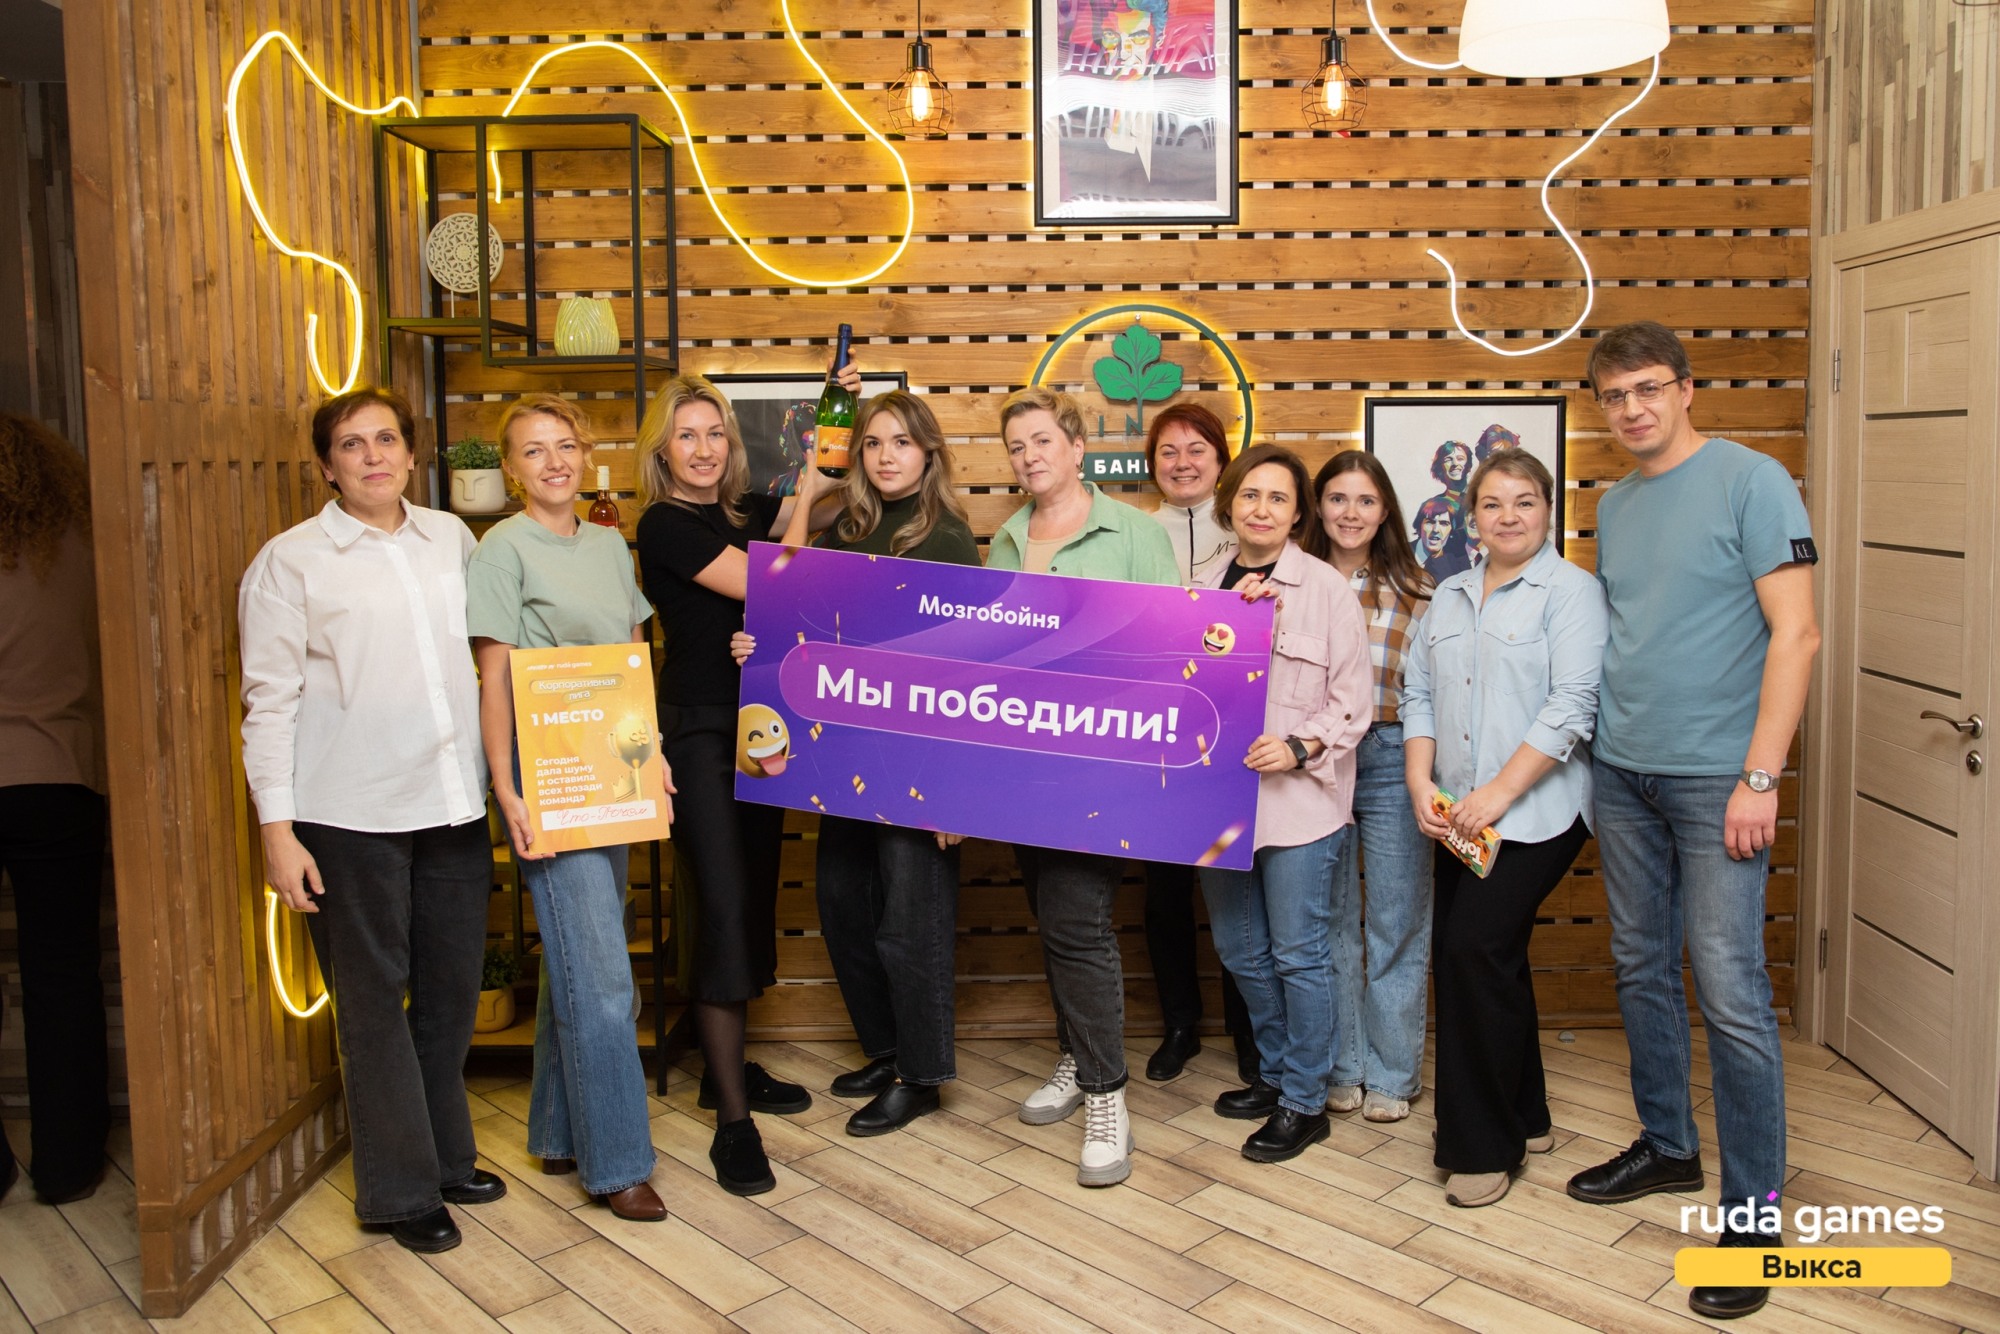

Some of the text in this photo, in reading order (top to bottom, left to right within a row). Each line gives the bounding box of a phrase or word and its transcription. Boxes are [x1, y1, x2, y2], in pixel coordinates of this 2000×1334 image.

[918, 593, 1060, 630] Мозгобойня
[538, 677, 617, 691] Корпоративная
[568, 690, 590, 700] лига
[816, 664, 1179, 744] Мы победили!
[531, 709, 604, 726] 1 МЕСТО
[535, 755, 580, 766] Сегодня
[536, 764, 594, 777] дала шуму
[537, 774, 596, 787] и оставила
[538, 783, 603, 797] всех позади
[539, 795, 586, 807] команда
